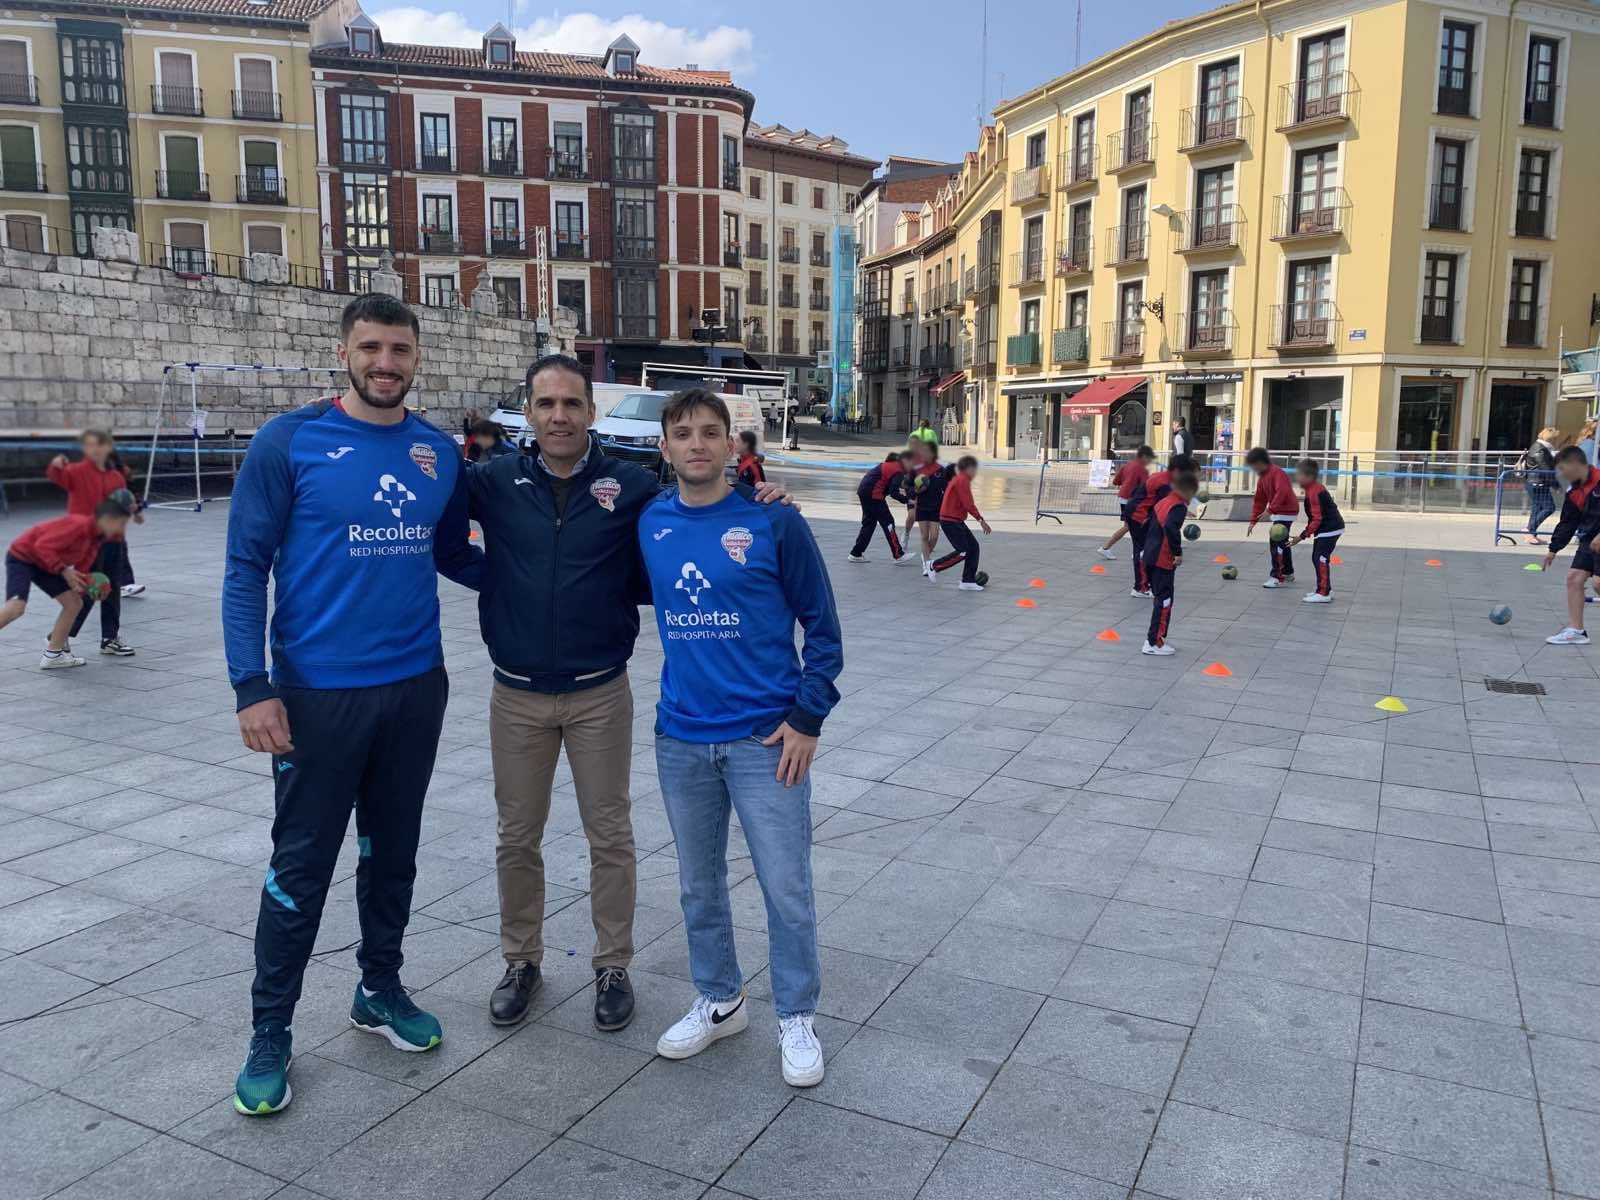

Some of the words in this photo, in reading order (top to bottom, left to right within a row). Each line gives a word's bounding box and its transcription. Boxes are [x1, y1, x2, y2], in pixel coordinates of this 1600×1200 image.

[349, 522, 432, 541] Recoletas
[350, 547, 371, 557] RED
[664, 609, 740, 626] Recoletas
